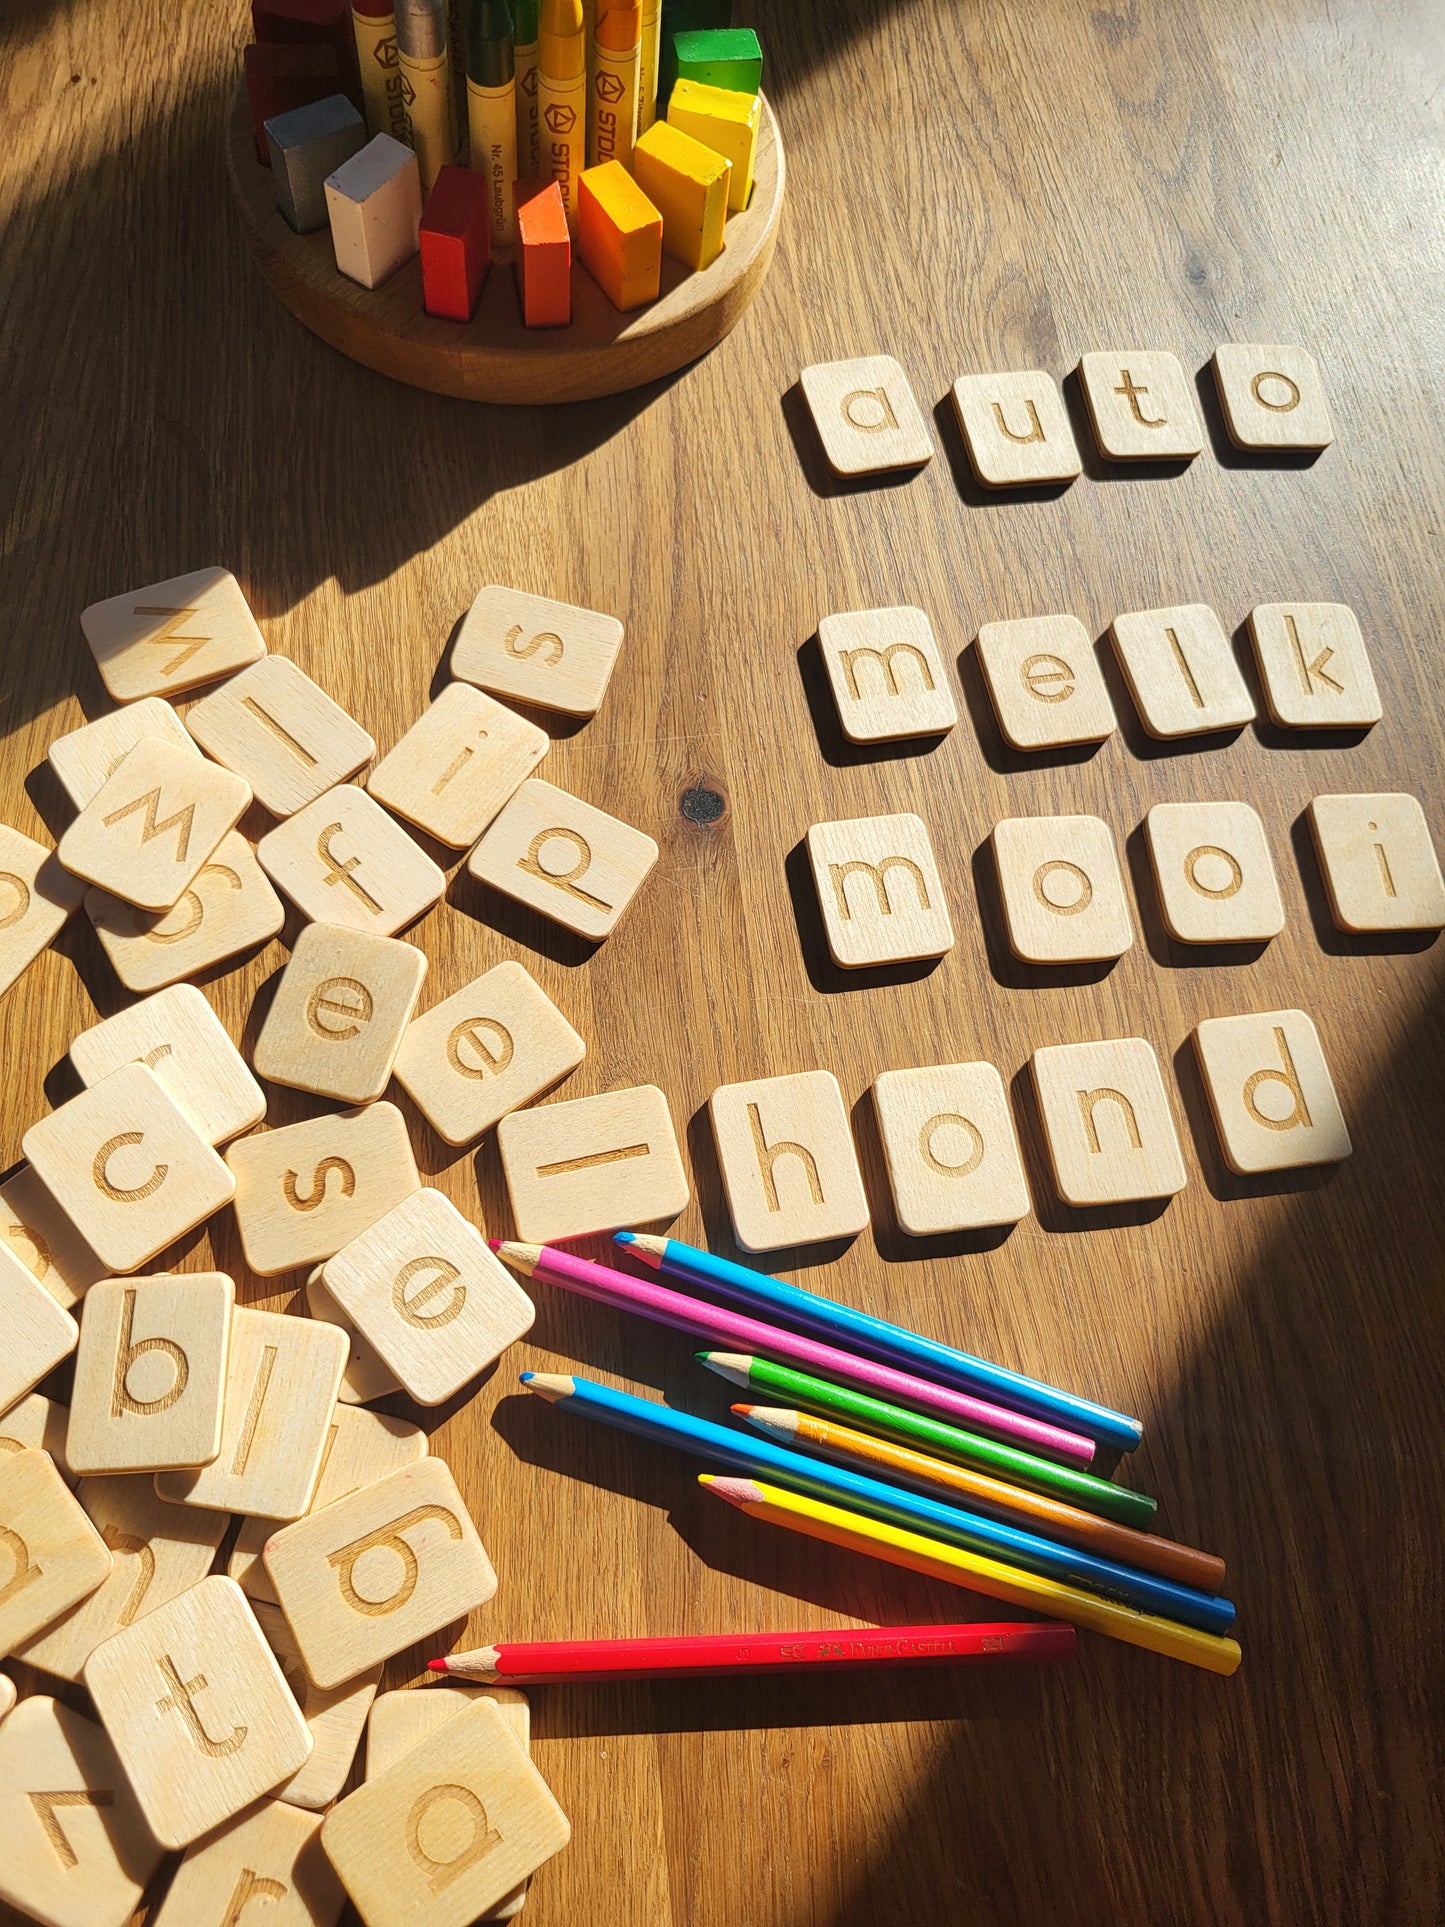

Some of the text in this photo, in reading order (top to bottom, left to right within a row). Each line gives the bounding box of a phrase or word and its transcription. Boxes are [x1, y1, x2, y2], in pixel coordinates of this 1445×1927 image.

[491, 144, 505, 231] Nr. 45 Laubgrün
[840, 369, 1301, 446] auto
[838, 614, 1345, 709] melk
[316, 821, 385, 917] f
[826, 820, 1398, 921] mooi
[306, 976, 374, 1042] e
[445, 1016, 515, 1081] e
[746, 1026, 1313, 1213] hond
[92, 1130, 169, 1203] c
[391, 1255, 467, 1330] e
[110, 1288, 190, 1418] b
[154, 1653, 249, 1758] t
